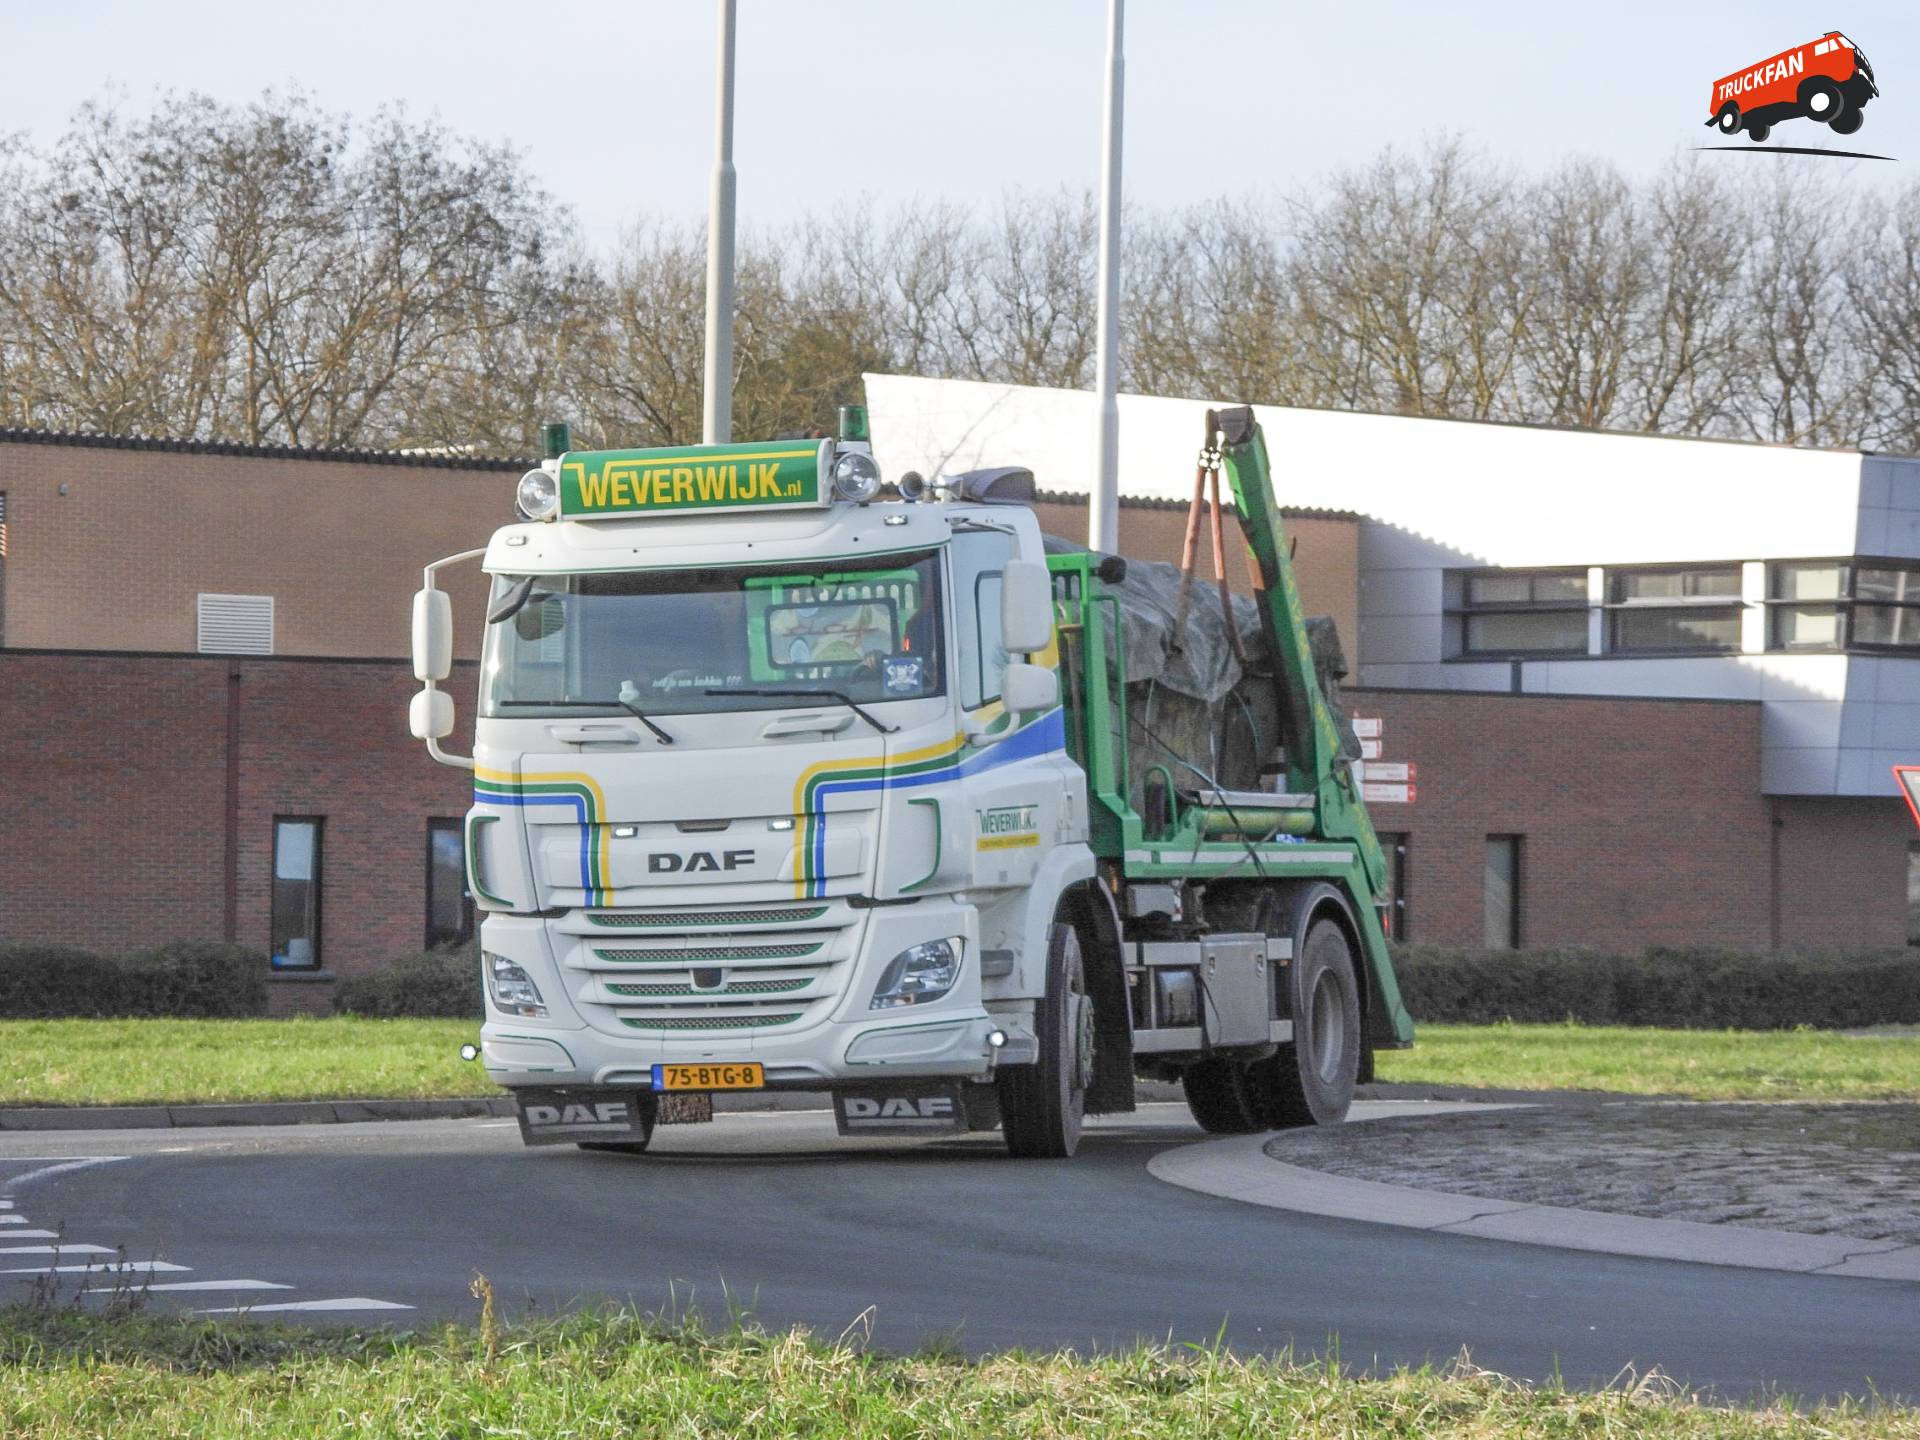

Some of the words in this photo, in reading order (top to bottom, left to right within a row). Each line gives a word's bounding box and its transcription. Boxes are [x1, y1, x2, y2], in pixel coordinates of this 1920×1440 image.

[648, 850, 755, 873] DAF
[668, 1067, 754, 1085] 75-BTG-8
[525, 1103, 628, 1125] DAF
[843, 1098, 952, 1116] DAF
